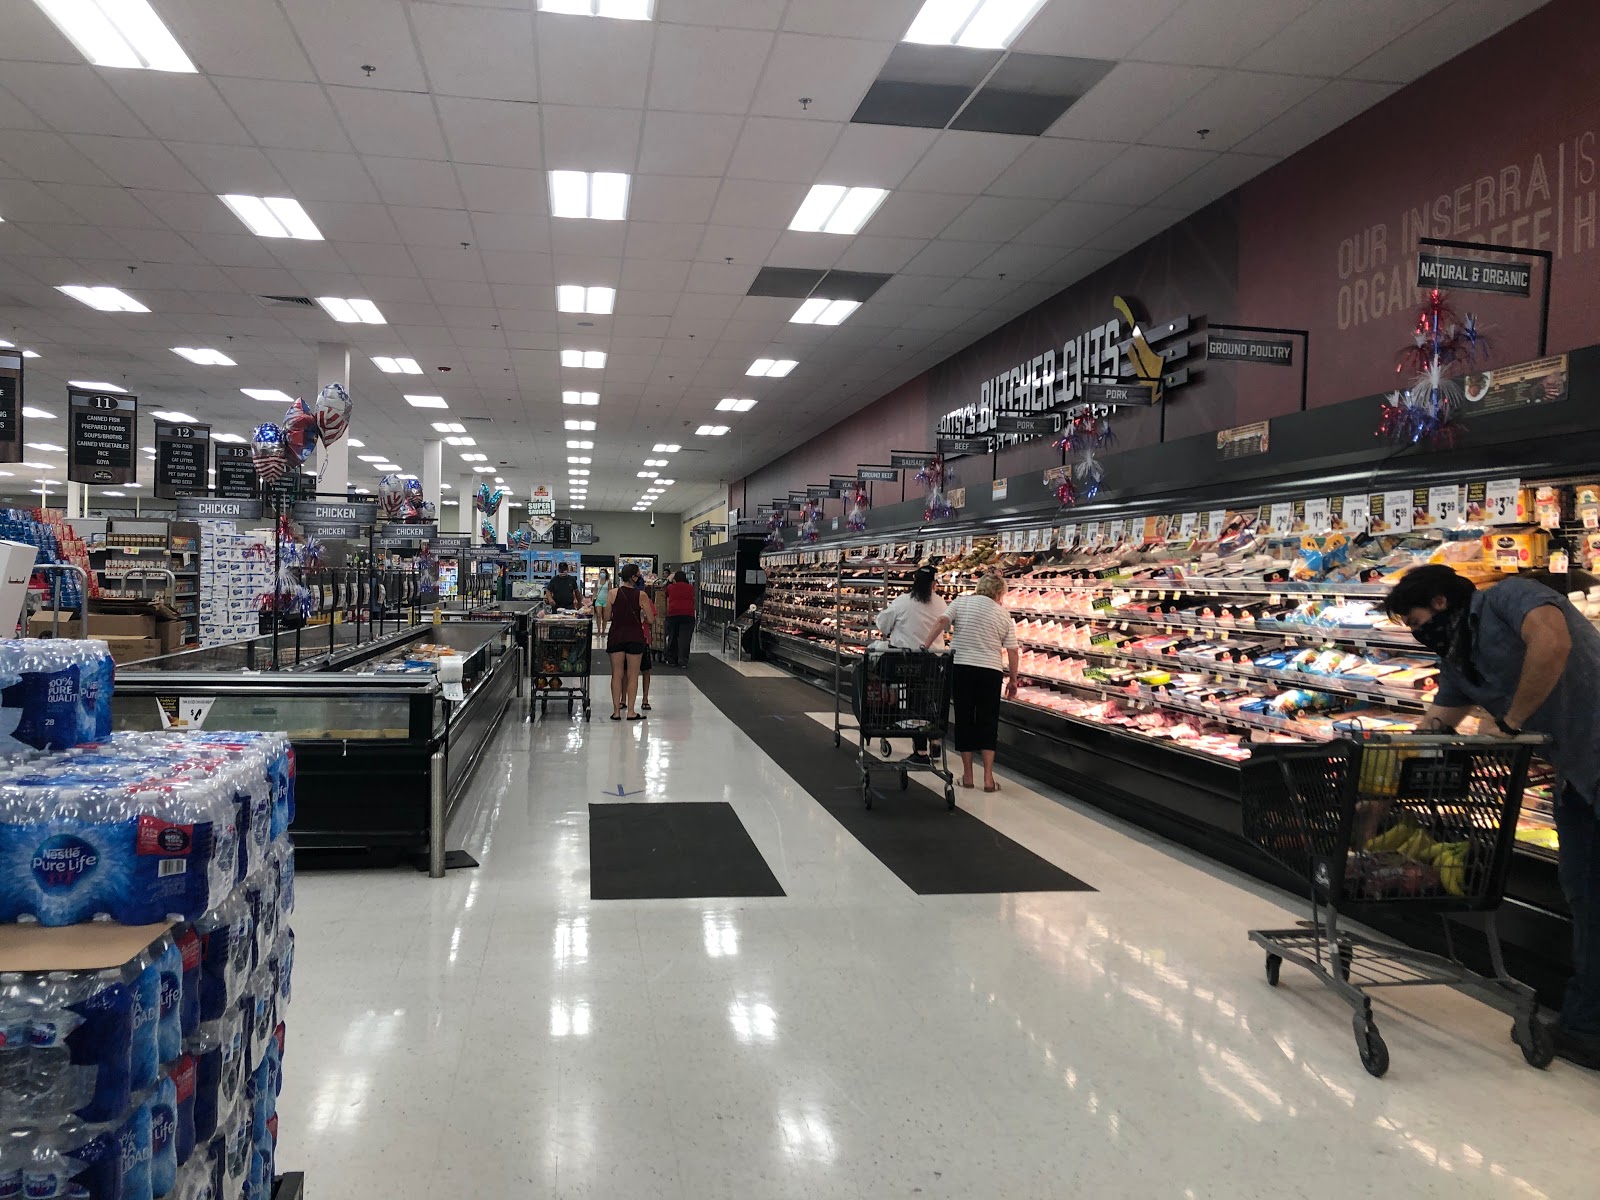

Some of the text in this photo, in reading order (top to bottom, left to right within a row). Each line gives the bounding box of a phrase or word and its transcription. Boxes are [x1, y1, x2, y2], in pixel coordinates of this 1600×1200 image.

[1337, 153, 1551, 280] OUR INSERRA
[1421, 262, 1528, 287] NATURAL & ORGANIC
[1209, 342, 1290, 358] GROUND POULTRY
[980, 349, 1055, 433] BUTCHER
[1062, 318, 1120, 402] CUTS
[1105, 389, 1127, 399] PORK
[95, 397, 111, 409] 11
[81, 423, 108, 431] PREPARED
[1017, 421, 1035, 430] PORK
[84, 432, 122, 441] SOUPS/BROTHS
[176, 428, 190, 437] 12
[954, 442, 970, 450] BEEF
[233, 448, 244, 457] 13
[199, 503, 240, 515] CHICKEN
[527, 502, 551, 510] SUPER
[316, 507, 356, 519] CHICKEN
[396, 528, 424, 536] CHICKEN
[48, 685, 73, 695] PURE
[47, 693, 78, 702] QUALIT
[43, 846, 82, 860] Nestlé
[33, 855, 97, 873] Pure Life
[154, 1121, 175, 1142] Life
